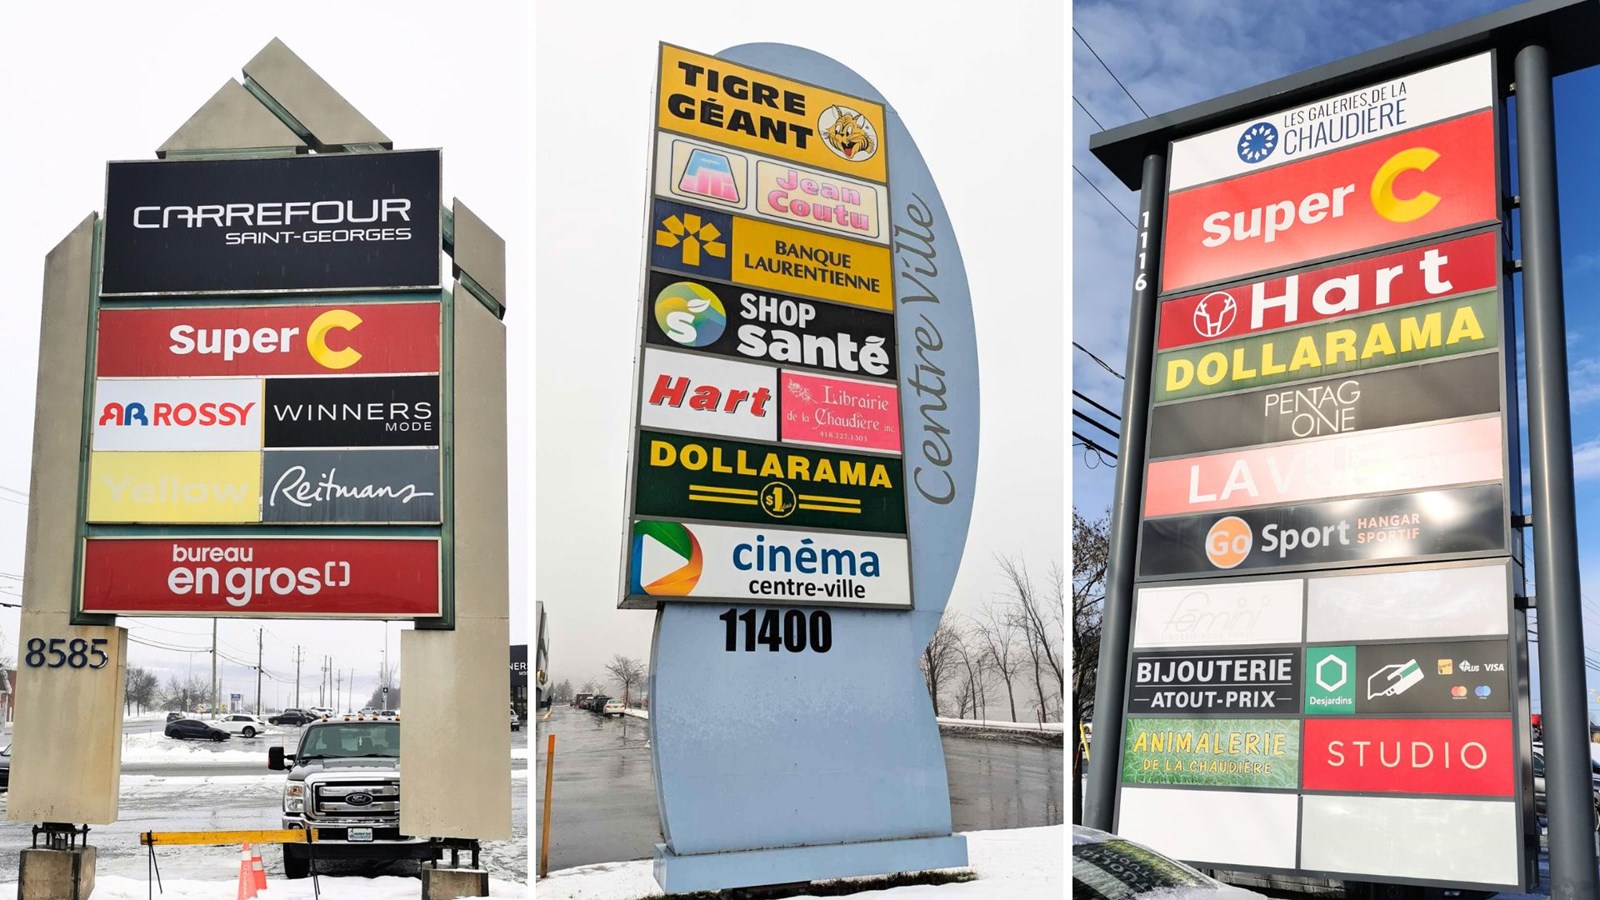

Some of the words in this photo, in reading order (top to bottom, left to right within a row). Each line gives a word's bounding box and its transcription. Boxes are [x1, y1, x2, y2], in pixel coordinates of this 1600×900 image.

[678, 60, 806, 117] TIGRE
[1284, 110, 1304, 128] LES
[1308, 92, 1368, 121] GALERIES
[1371, 86, 1387, 104] DE
[1391, 81, 1407, 98] LA
[667, 93, 813, 150] GÉANT
[1283, 97, 1407, 156] CHAUDIÈRE
[776, 169, 861, 206] Jean
[1201, 183, 1355, 248] Super
[1370, 146, 1442, 224] C
[132, 198, 412, 230] CARREFOUR
[767, 190, 870, 231] Coutu
[225, 227, 412, 245] SAINT-GEORGES
[775, 240, 852, 269] BANQUE
[893, 191, 941, 306] Ville
[744, 253, 880, 293] LAURENTIENNE
[1250, 248, 1454, 330] Hart
[739, 292, 816, 329] SHOP
[168, 324, 300, 362] Super
[306, 309, 364, 370] C
[736, 323, 890, 376] santé
[1165, 306, 1486, 393] DOLLARAMA
[153, 401, 257, 427] ROSSY
[273, 401, 433, 422] WINNERS
[648, 374, 772, 418] Hart
[822, 385, 889, 411] Librairie
[907, 313, 956, 505] Centre
[385, 421, 433, 432] MODE
[786, 410, 798, 422] de
[801, 411, 810, 423] la
[812, 407, 880, 431] Chaudière
[649, 439, 893, 490] DOLLARAMA
[100, 474, 250, 505] Yellow
[269, 465, 435, 508] Reitmans
[1207, 530, 1251, 557] Go
[1260, 519, 1350, 558] Sport
[1357, 513, 1420, 530] HANGAR
[1357, 527, 1420, 544] SPORTIF
[172, 543, 253, 563] bureau
[732, 534, 881, 577] cinéma
[167, 566, 219, 595] en
[225, 566, 321, 607] gros
[749, 578, 866, 599] centre-ville
[719, 608, 833, 653] 11400
[25, 637, 109, 669] 8585
[1136, 658, 1292, 684] BIJOUTERIE
[1483, 663, 1505, 672] VISA
[1150, 690, 1276, 709] ATOUT-PRIX
[1309, 695, 1353, 707] Desjardins
[1133, 731, 1287, 756] ANIMALERIE
[1326, 740, 1488, 770] STUDIO
[1143, 759, 1160, 771] DE
[1165, 760, 1184, 772] LA
[1189, 758, 1273, 774] CHAUDIÈRE
